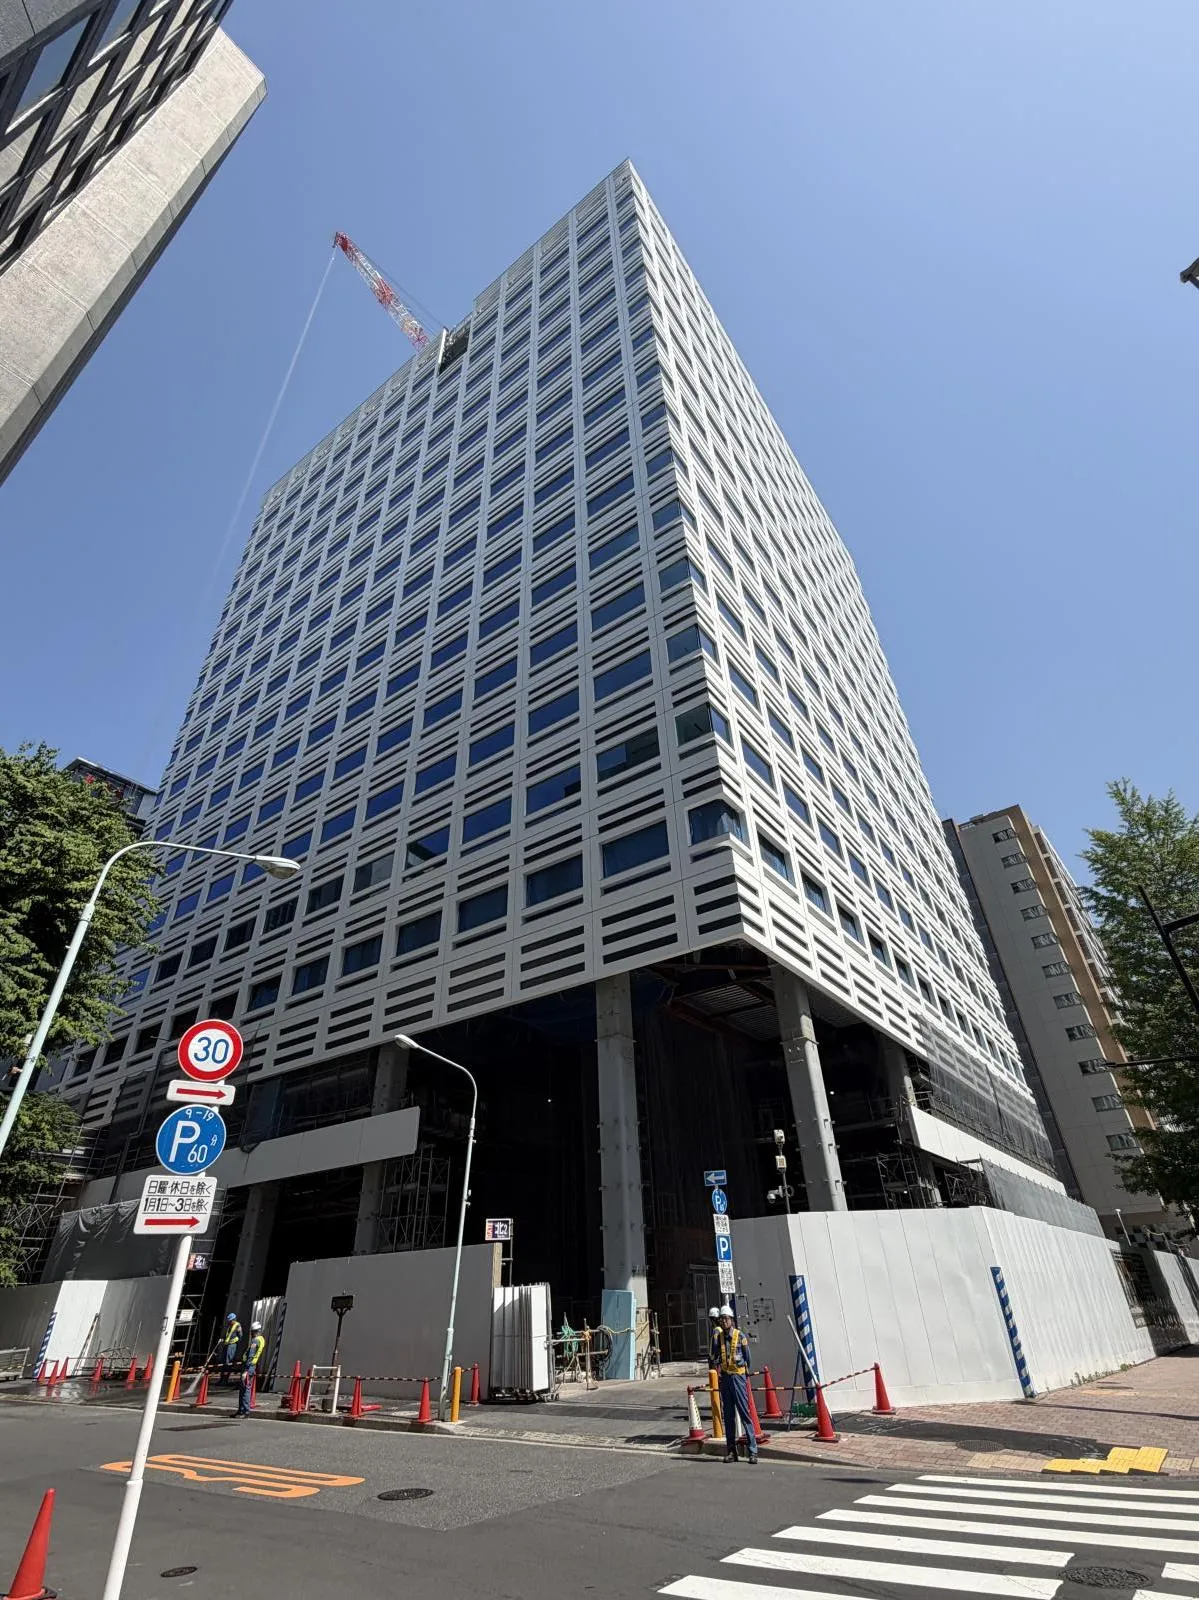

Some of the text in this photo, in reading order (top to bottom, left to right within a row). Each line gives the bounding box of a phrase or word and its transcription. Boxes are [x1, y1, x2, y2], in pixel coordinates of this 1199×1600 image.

[193, 1036, 230, 1065] 30
[185, 1108, 215, 1122] 9-19
[168, 1120, 201, 1163] P
[187, 1144, 208, 1164] 60
[719, 1236, 729, 1259] P
